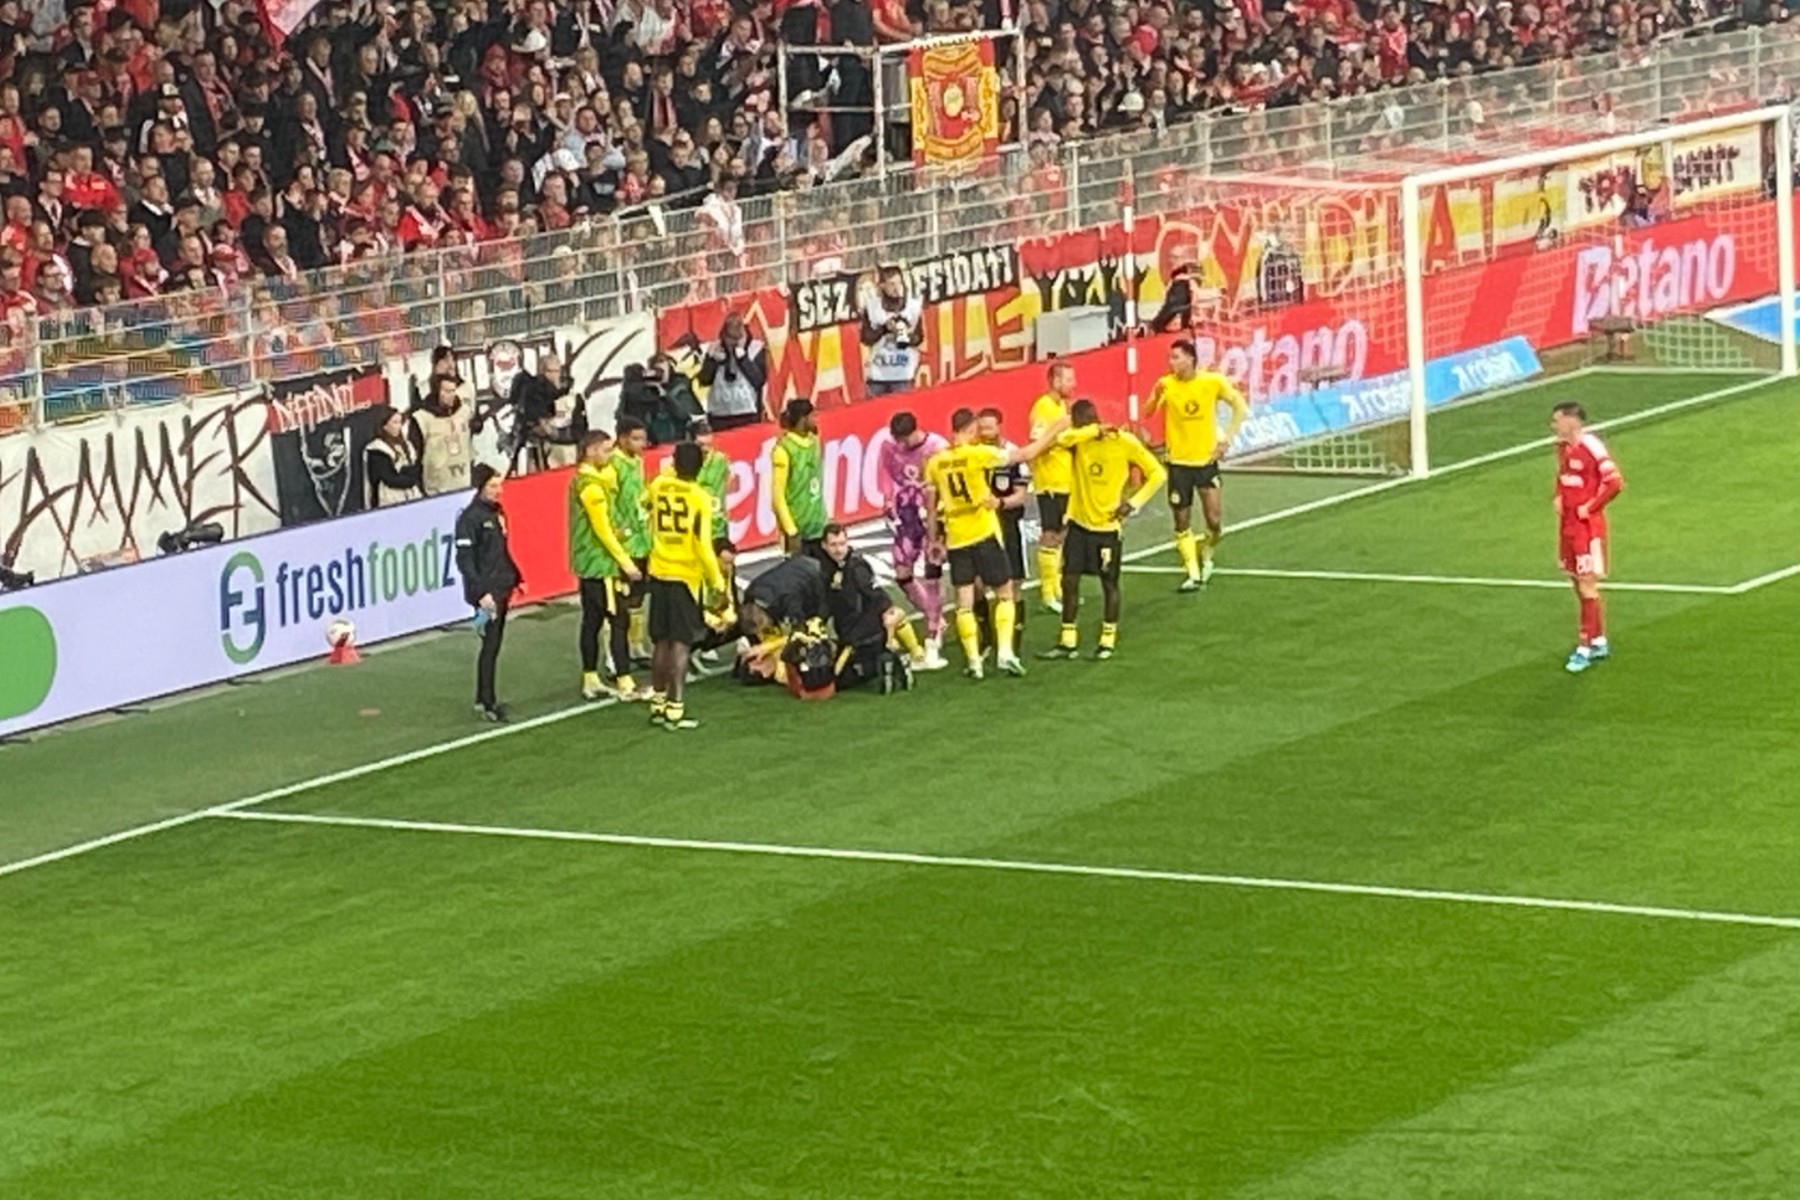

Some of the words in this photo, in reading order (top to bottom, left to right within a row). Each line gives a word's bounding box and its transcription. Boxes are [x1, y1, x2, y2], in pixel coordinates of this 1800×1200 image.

[1572, 234, 1736, 334] Betano
[0, 396, 283, 583] AMMER
[657, 494, 699, 534] 22
[947, 471, 973, 504] 4
[275, 527, 457, 628] freshfoodz
